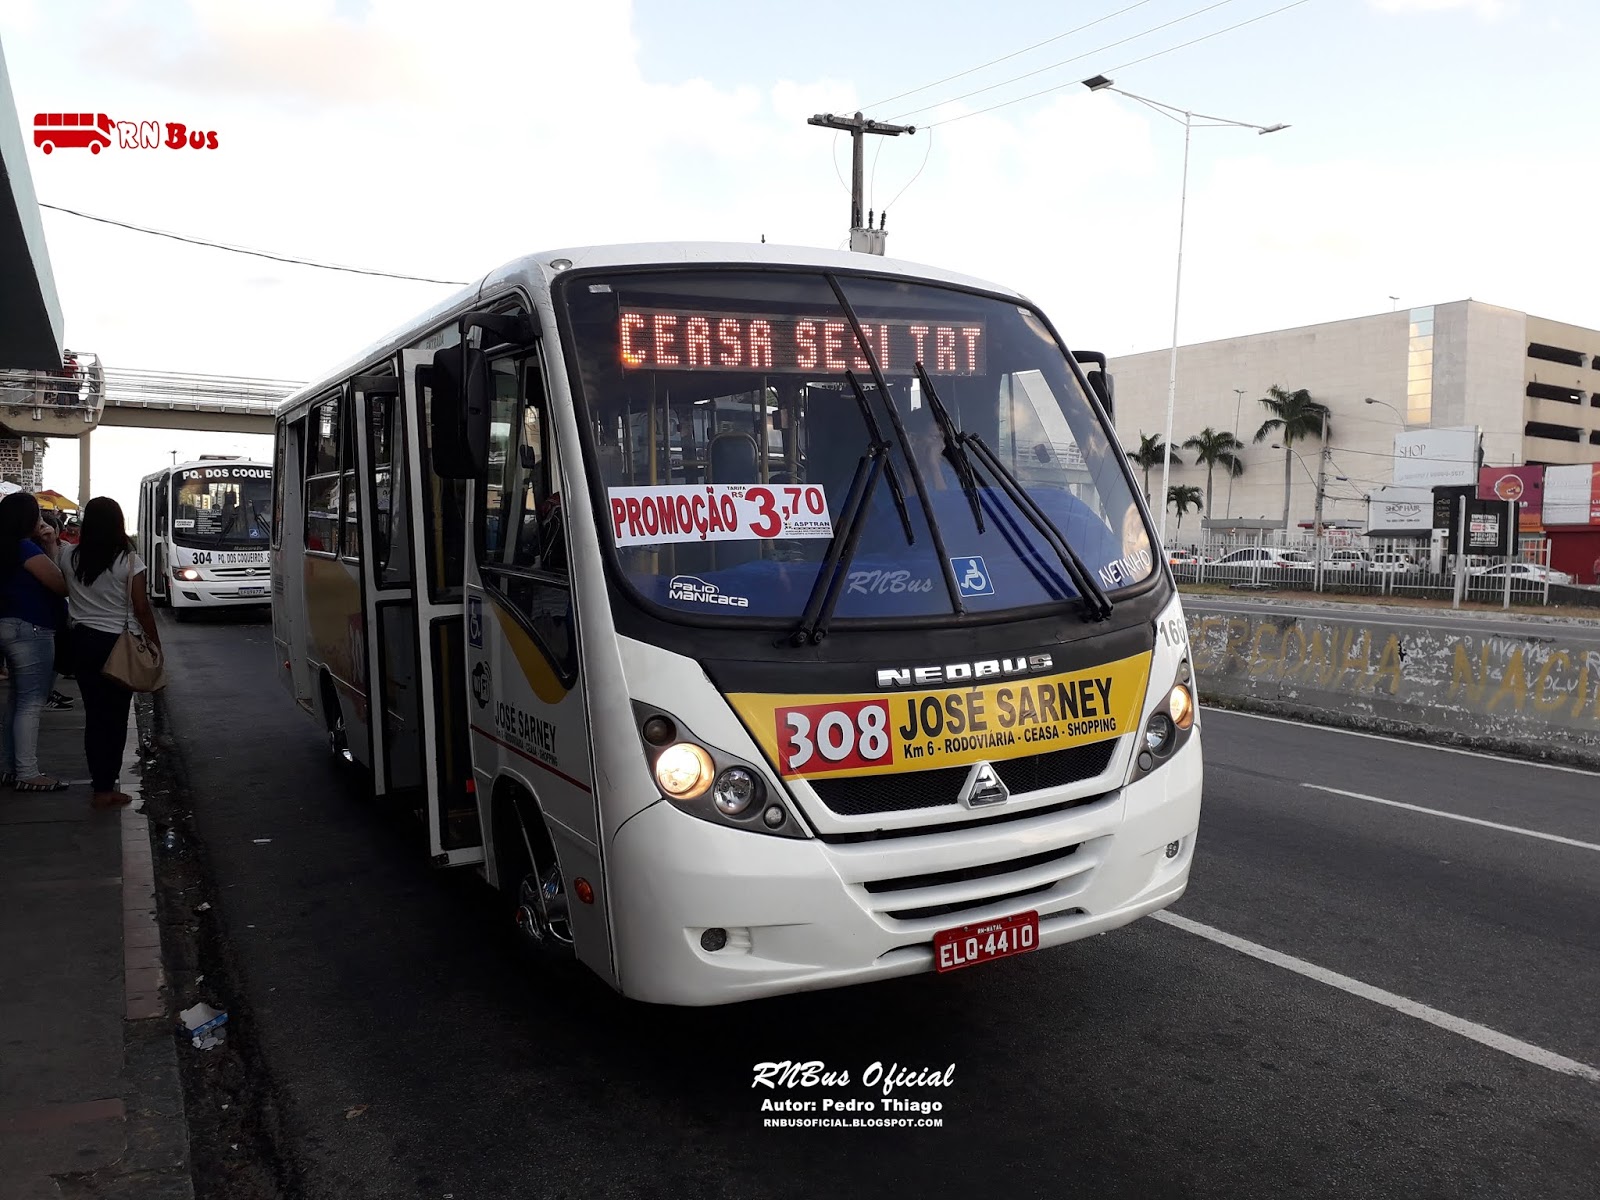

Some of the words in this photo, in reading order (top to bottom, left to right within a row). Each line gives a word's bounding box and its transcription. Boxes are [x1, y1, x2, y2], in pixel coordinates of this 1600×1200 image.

[621, 313, 772, 367] CEASA
[796, 321, 889, 369] SESI
[910, 325, 981, 371] TRT
[1400, 444, 1426, 457] SHOP
[205, 468, 229, 478] DOS
[232, 468, 272, 479] COQUE
[611, 486, 738, 540] PROMOÇÃO
[192, 552, 212, 565] 304
[227, 553, 237, 563] DOS
[237, 553, 264, 563] COQUEIROS
[1098, 549, 1151, 589] NETINHO
[877, 654, 1053, 687] NEOBUS
[1450, 643, 1600, 719] NACI
[495, 701, 516, 734] JOSÉ
[518, 710, 556, 753] SARNEY
[899, 685, 988, 741] JOSÉ
[996, 677, 1113, 728] SARNEY
[786, 705, 889, 769] 308
[903, 743, 924, 759] Km
[927, 740, 934, 755] 6
[944, 730, 1015, 753] RODOVIÁRIA
[1024, 726, 1059, 743] CEASA
[1067, 717, 1117, 737] SHOPPING
